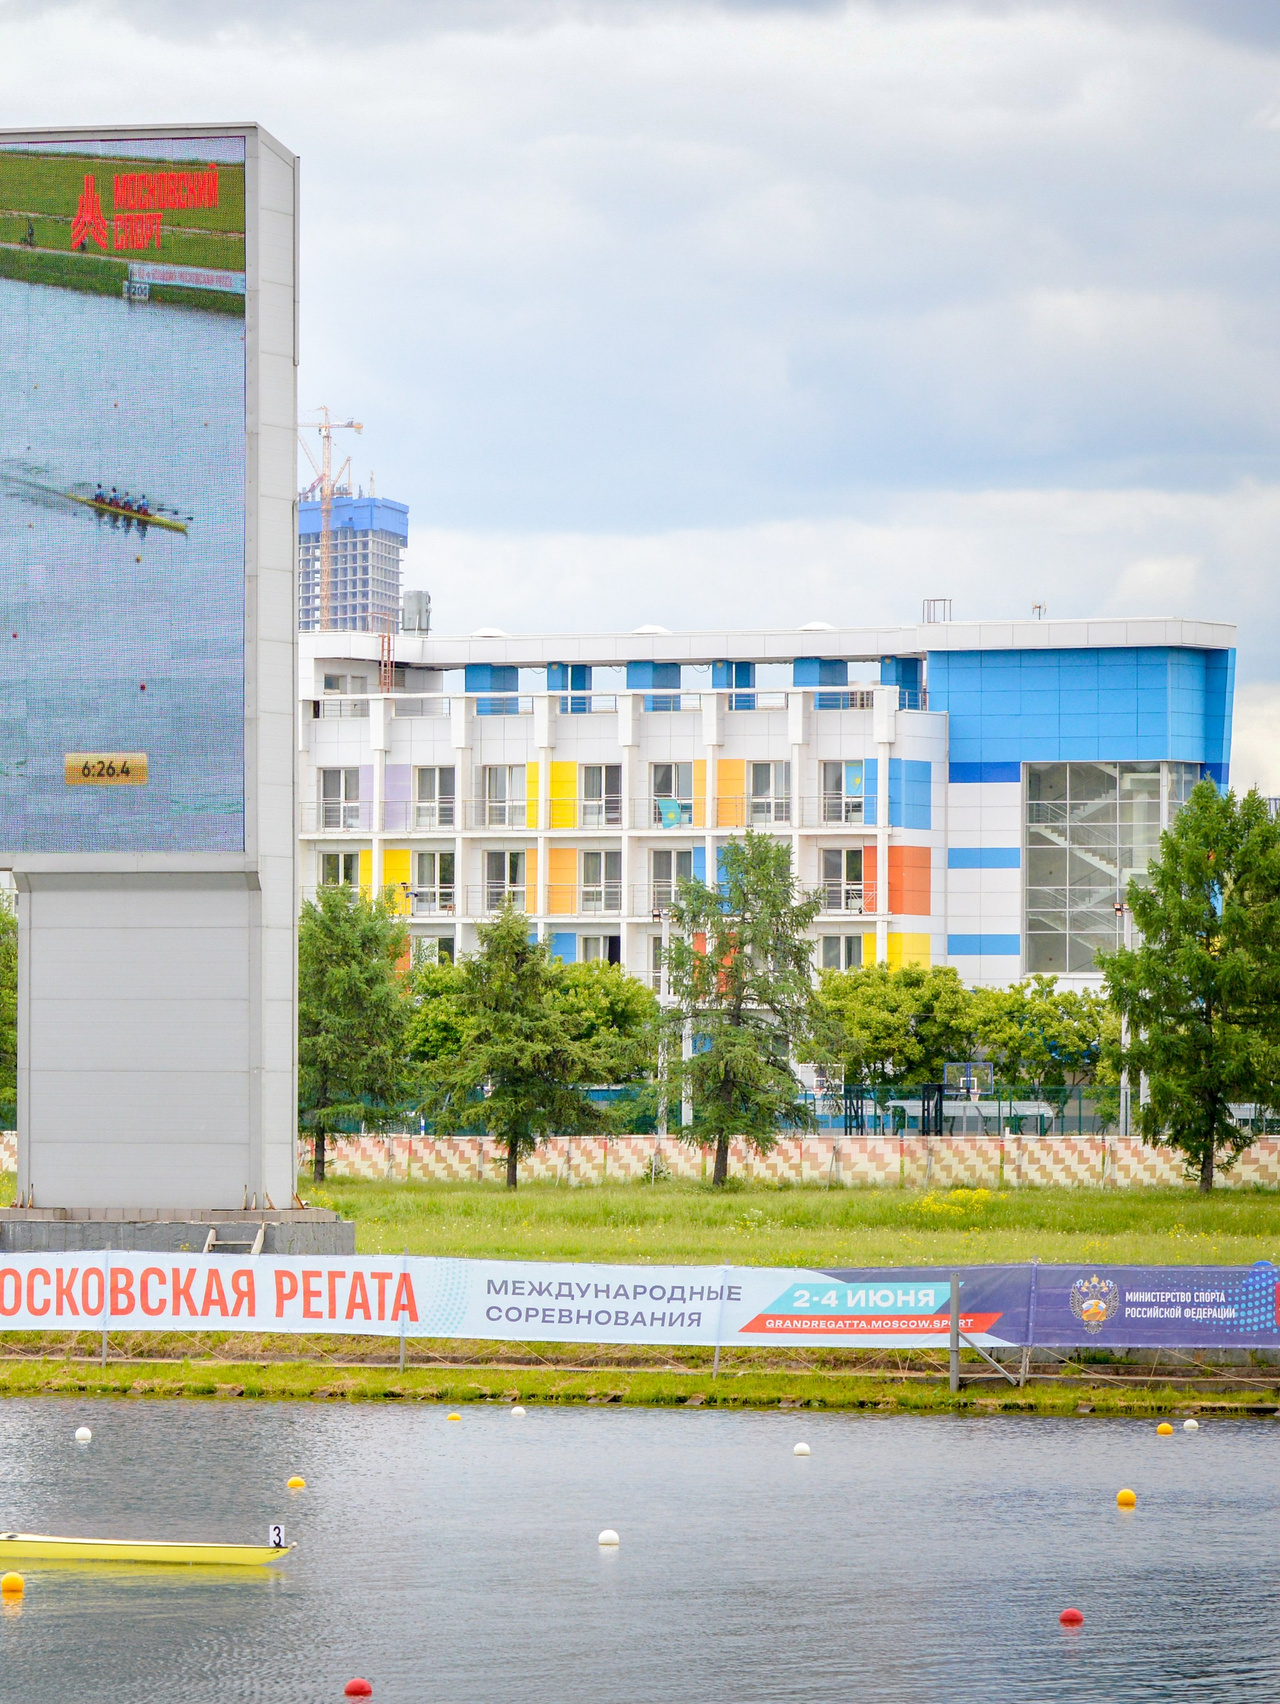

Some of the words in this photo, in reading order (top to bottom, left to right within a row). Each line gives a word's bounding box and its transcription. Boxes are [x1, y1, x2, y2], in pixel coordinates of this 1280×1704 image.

[114, 163, 218, 210] МОСКОВСКИЙ
[114, 213, 163, 250] СПОРТ
[82, 761, 130, 777] 6:26.4
[274, 1269, 419, 1322] РЕГАТА
[486, 1279, 742, 1304] МЕЖДУНАРОДНЫЕ
[793, 1289, 838, 1308] 2-4
[847, 1289, 935, 1308] ИЮНЯ
[1125, 1291, 1191, 1303] МИНИСТЕРСТВО
[1193, 1292, 1226, 1303] СПОРТА
[485, 1305, 702, 1328] СОРЕВНОВАНИЯ
[1124, 1305, 1182, 1319] РОССИЙСКОЙ
[1183, 1307, 1236, 1320] ФЕДЕРАЦИИ
[765, 1318, 974, 1329] GRANDREGATTA.MOSCOW.SPRT
[273, 1526, 282, 1547] 3
